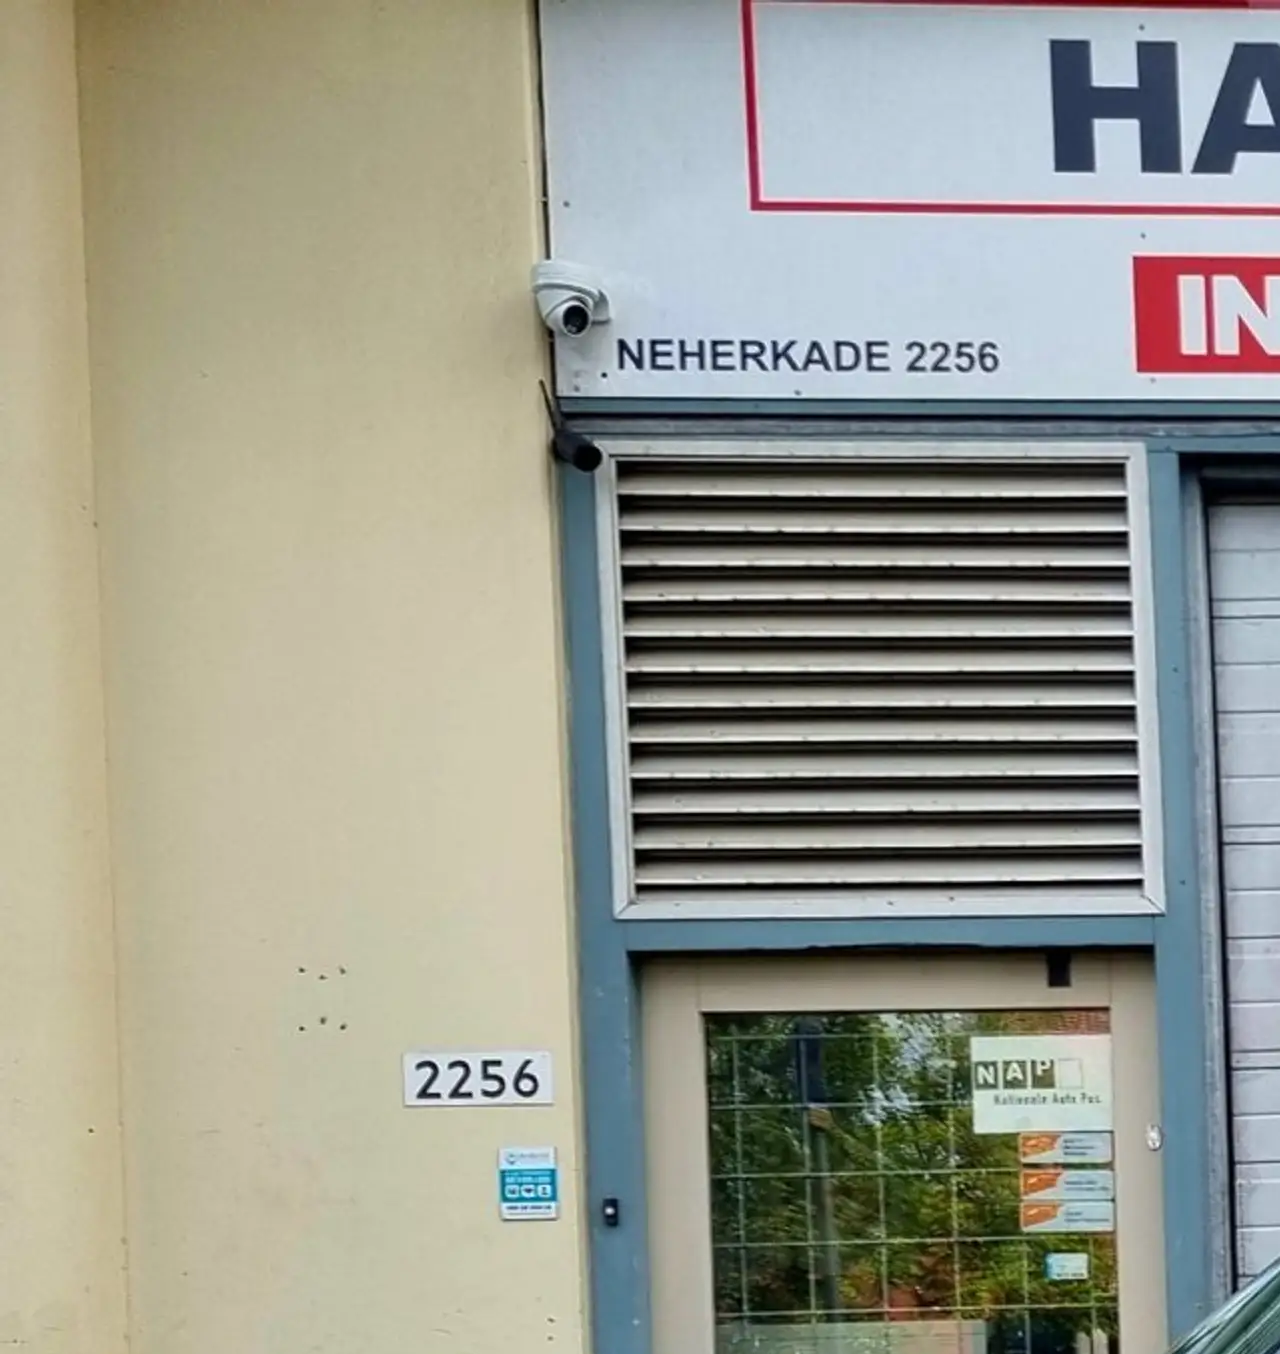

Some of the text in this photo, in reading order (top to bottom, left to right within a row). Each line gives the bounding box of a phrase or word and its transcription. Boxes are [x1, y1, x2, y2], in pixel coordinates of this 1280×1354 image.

[616, 338, 1000, 373] NEHERKADE 2256
[414, 1059, 540, 1100] 2256
[976, 1058, 1052, 1086] NAP
